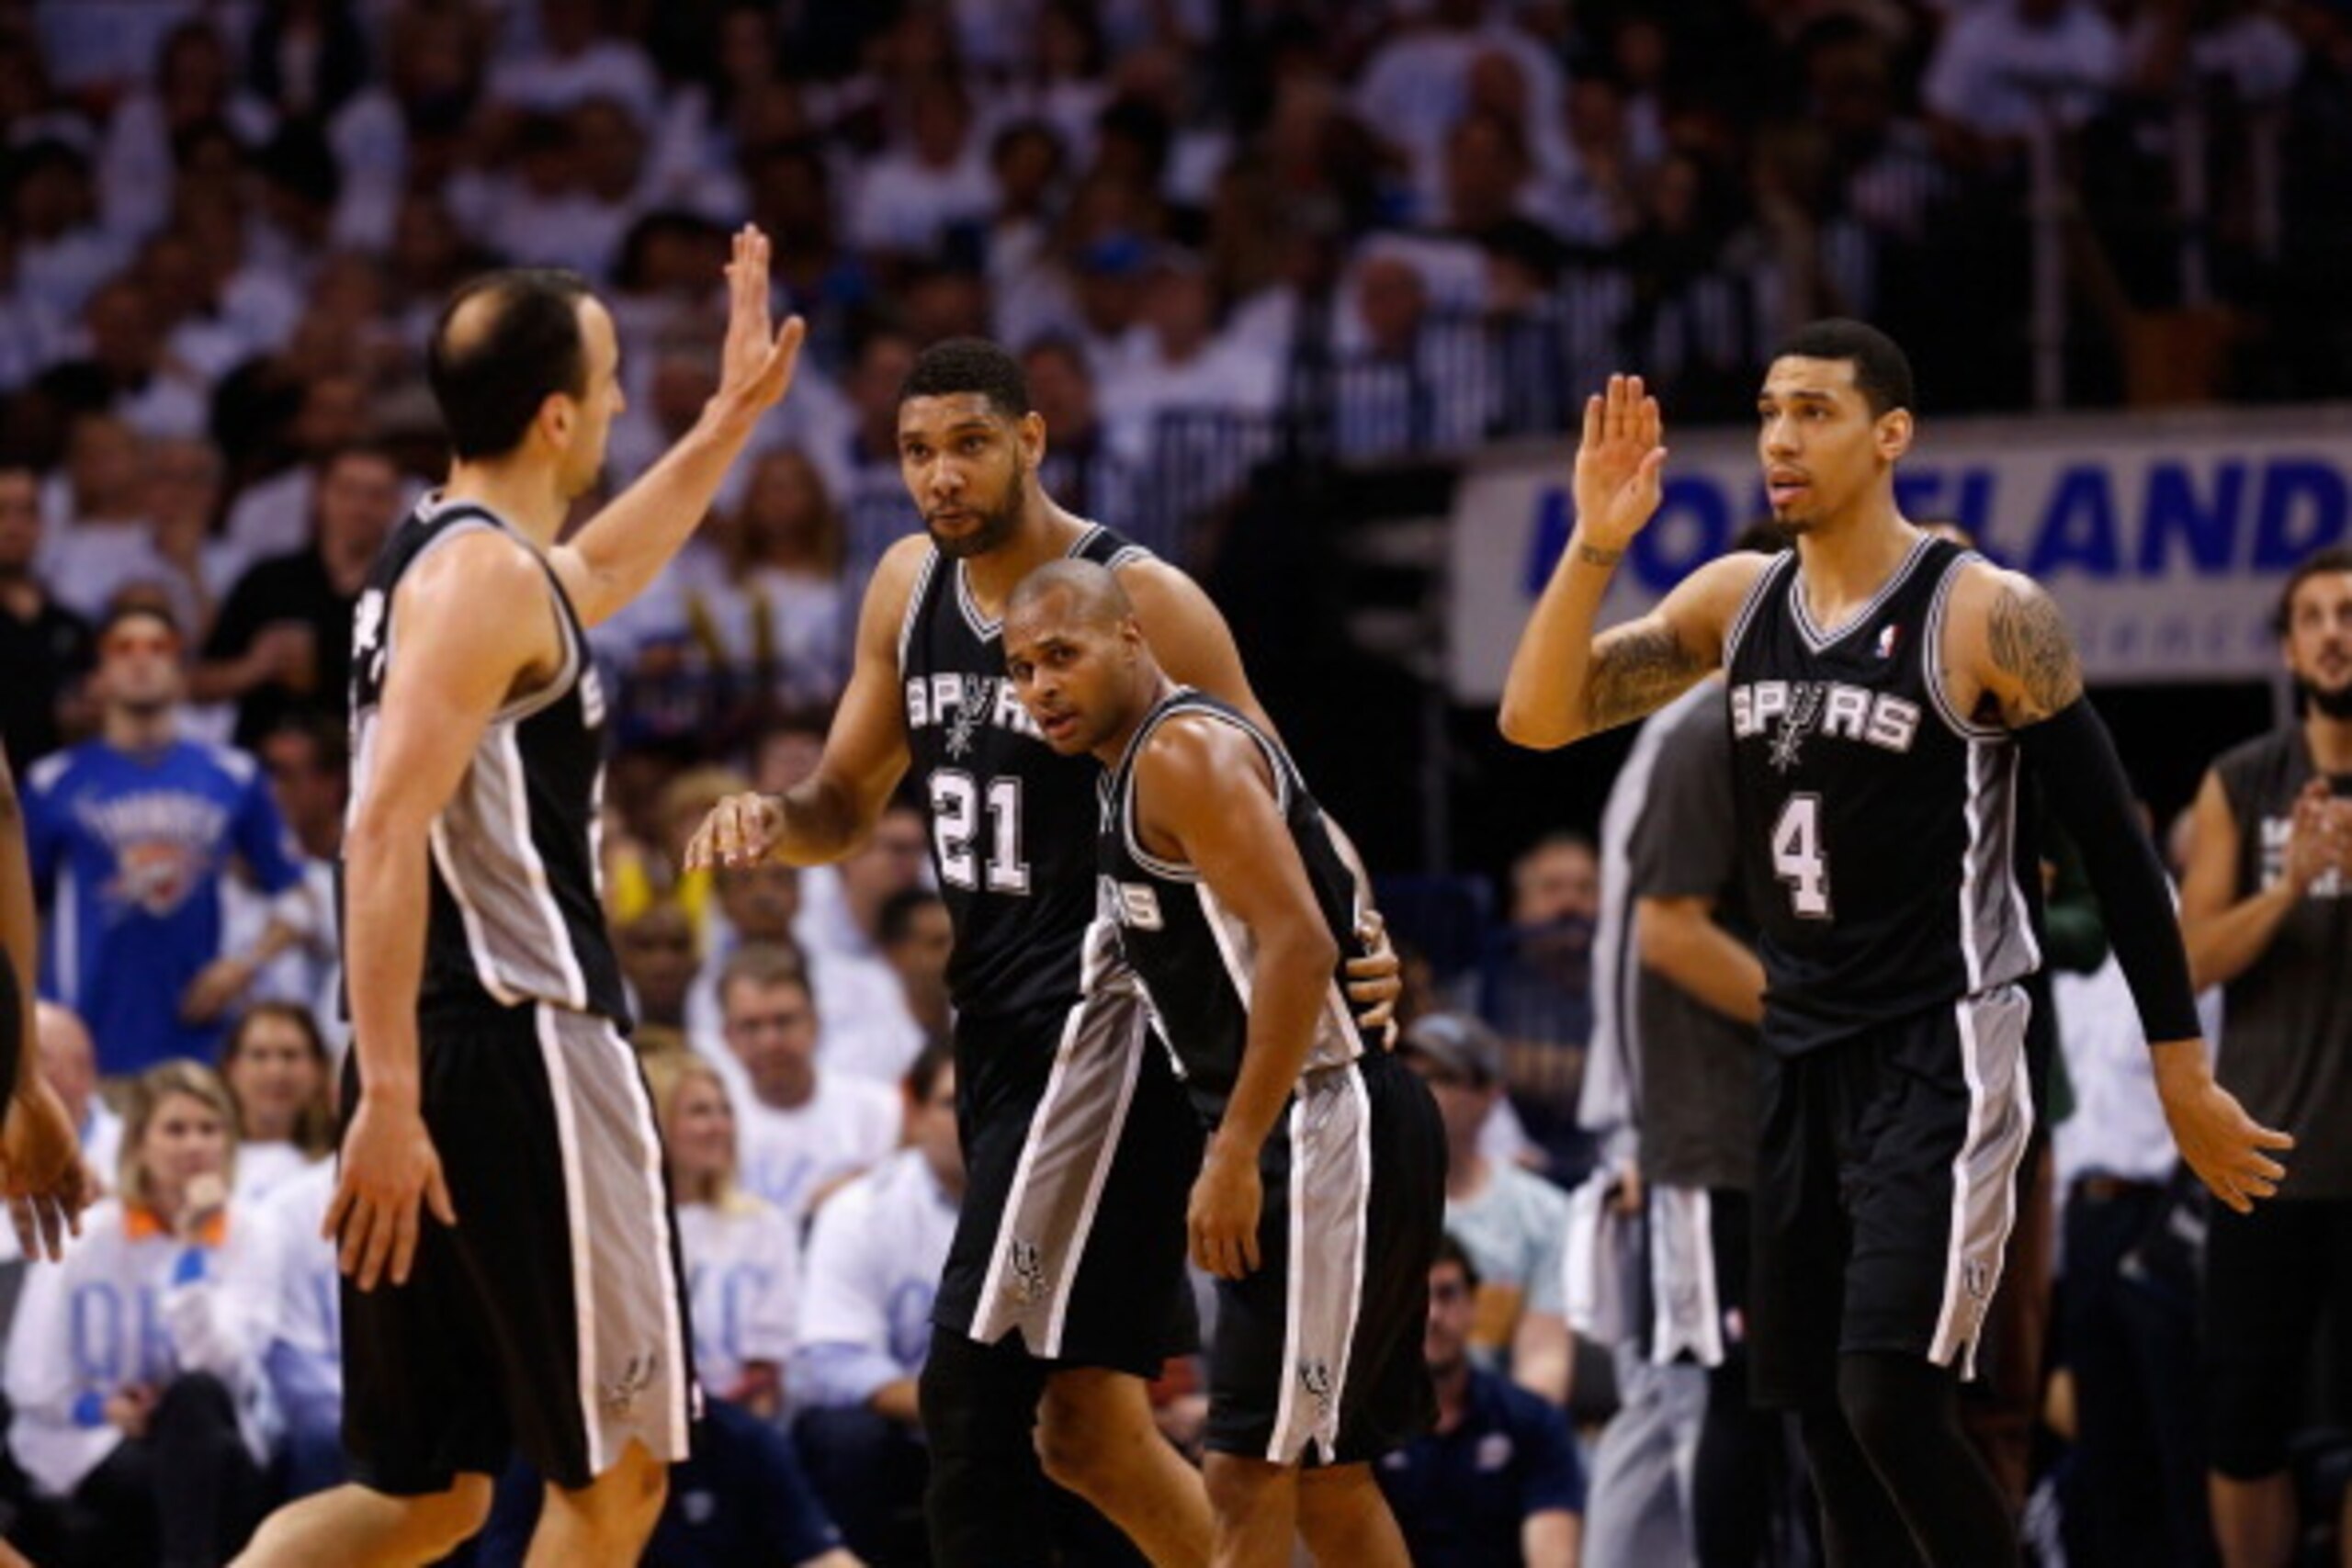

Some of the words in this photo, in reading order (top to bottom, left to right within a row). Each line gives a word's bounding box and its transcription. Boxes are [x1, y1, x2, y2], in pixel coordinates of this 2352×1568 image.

[1730, 679, 1920, 773] SPURS
[929, 768, 1031, 896] 21
[1772, 790, 1833, 922] 4
